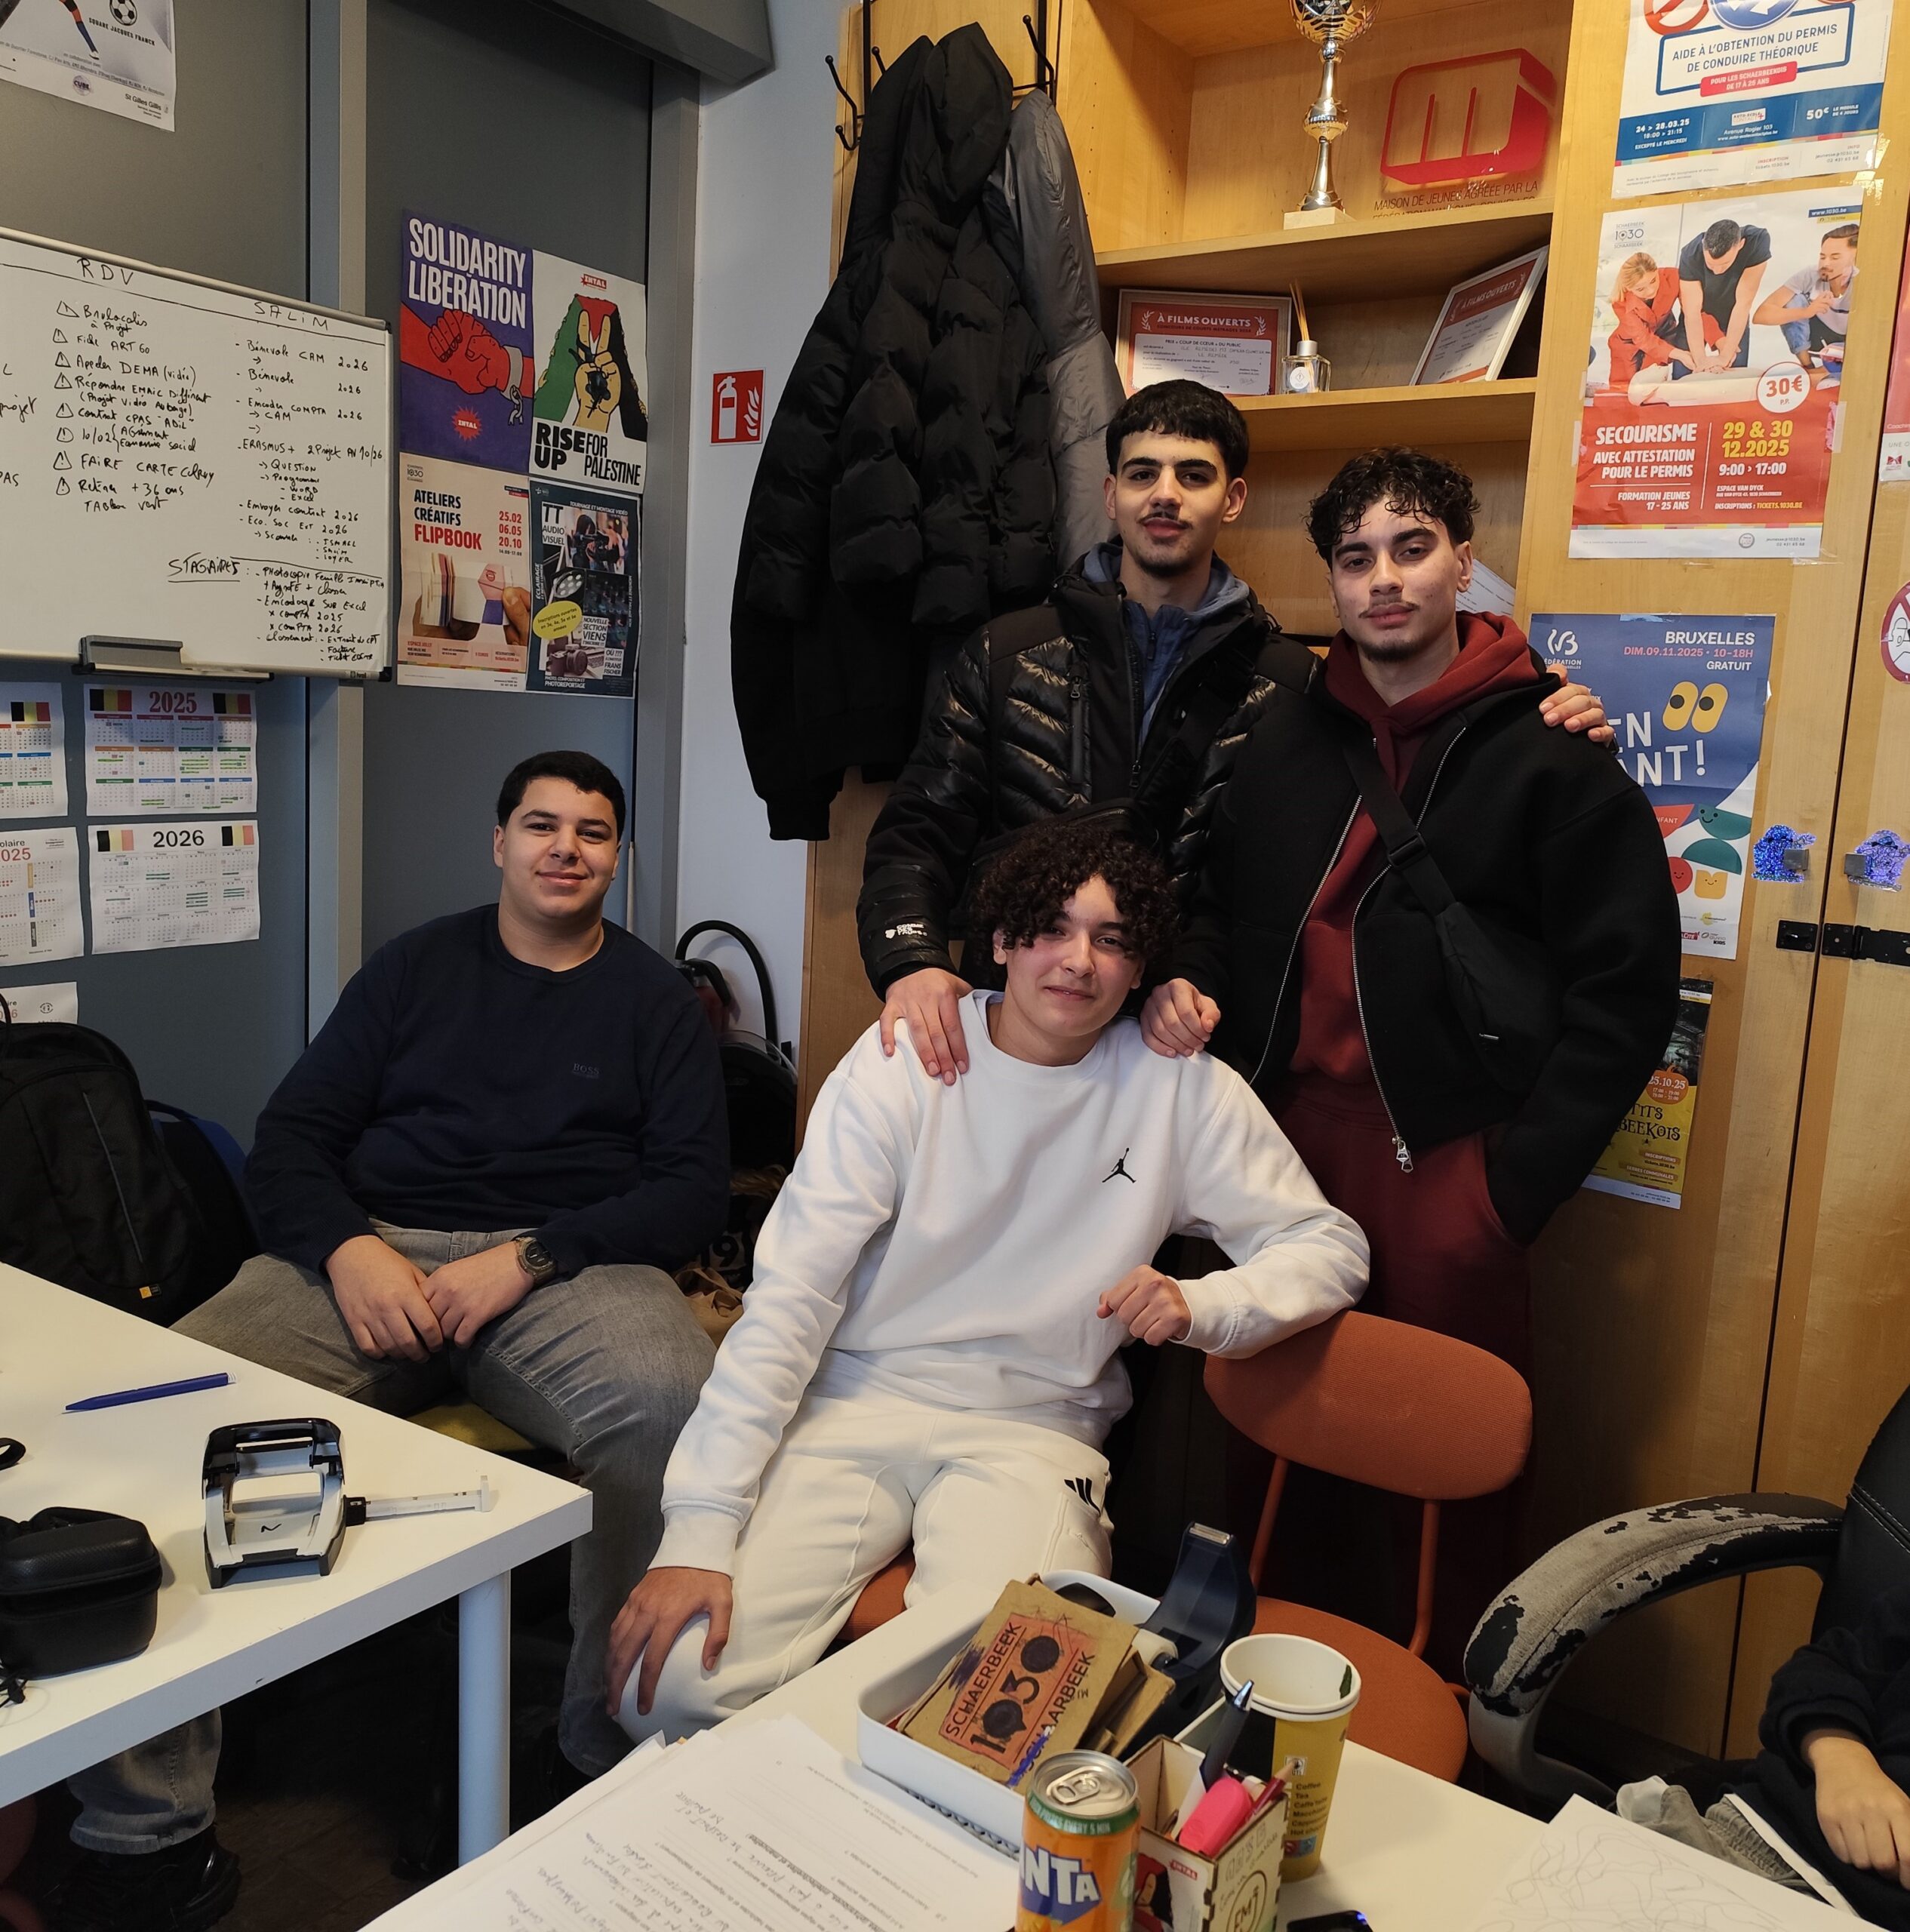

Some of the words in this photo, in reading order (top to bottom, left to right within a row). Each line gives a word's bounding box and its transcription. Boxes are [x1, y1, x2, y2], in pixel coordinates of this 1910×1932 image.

[88, 17, 109, 30] SQUARE
[110, 26, 134, 38] JACQUES
[134, 33, 155, 46] FRANCK
[1672, 45, 1696, 61] AIDE
[1698, 43, 1706, 56] À
[1777, 32, 1792, 48] DU
[1795, 23, 1838, 45] PERMIS
[1687, 62, 1700, 73] DE
[1702, 52, 1756, 71] CONDUIRE
[1759, 42, 1819, 63] THÉORIQUE
[1710, 75, 1727, 85] POUR
[1727, 73, 1738, 83] LES
[1739, 66, 1788, 82] SCHAERBEEKOIS
[1726, 82, 1735, 91] DE
[1736, 81, 1741, 89] 17
[1741, 78, 1748, 88] À
[1757, 76, 1770, 85] ANS
[132, 97, 148, 106] Gilles
[148, 102, 161, 110] Gillis
[1806, 106, 1829, 122] 50€
[1635, 125, 1646, 134] 24
[1655, 118, 1690, 130] 28.03.25
[1724, 127, 1744, 136] Avenue
[1745, 125, 1762, 135] Rogier
[1663, 137, 1687, 147] MERCREDI
[1373, 198, 1410, 211] MAISON
[1411, 195, 1425, 207] DE
[1426, 192, 1462, 205] JEUNES
[1503, 183, 1523, 195] PAR
[1524, 180, 1538, 192] LA
[1615, 229, 1644, 242] 1030
[409, 218, 526, 288] SOLIDARITY
[77, 258, 134, 285] RDV
[1158, 312, 1164, 323] À
[1167, 315, 1200, 325] FILMS
[1201, 317, 1251, 327] OUVERTS
[111, 340, 137, 352] ART
[139, 343, 149, 354] 60
[299, 351, 324, 364] CAM
[338, 356, 368, 371] 2026
[118, 361, 159, 377] DEMA
[338, 383, 361, 395] 2026
[1766, 375, 1803, 398] 30€
[337, 409, 362, 420] 2026
[1595, 423, 1698, 445] SECOURISME
[1722, 421, 1746, 439] 29
[1749, 421, 1765, 438] &
[1769, 420, 1793, 438] 30
[536, 421, 586, 454] RISE
[586, 432, 608, 459] FOR
[1721, 439, 1790, 459] 12.2025
[534, 445, 567, 471] UP
[1593, 451, 1621, 465] AVEC
[1622, 449, 1696, 463] ATTESTATION
[137, 462, 178, 476] CARTE
[407, 468, 423, 478] 1030
[584, 454, 641, 487] PALESTINE
[1601, 466, 1632, 479] POUR
[1635, 466, 1647, 478] LE
[1650, 464, 1694, 478] PERMIS
[1718, 463, 1745, 476] 9:00
[1755, 462, 1787, 475] 17:00
[414, 489, 461, 509] ATELIERS
[1617, 491, 1662, 501] FORMATION
[1662, 491, 1691, 500] JEUNES
[570, 501, 591, 509] TOURNAGE
[1646, 502, 1654, 511] 17
[1660, 501, 1672, 510] 25
[1672, 501, 1690, 509] ANS
[334, 509, 358, 521] 2026
[414, 506, 461, 526] CRÉATIFS
[499, 511, 521, 524] 25.02
[322, 525, 347, 535] 2026
[414, 523, 482, 550] FLIPBOOK
[499, 524, 521, 536] 06.05
[543, 525, 564, 535] AUDIO
[499, 537, 522, 549] 20.10
[543, 535, 564, 545] VISUEL
[317, 612, 343, 622] 2025
[538, 614, 560, 623] Inscriptions
[561, 608, 577, 616] ouvertes
[318, 624, 343, 633] 2026
[583, 631, 606, 641] VIENS
[1665, 631, 1756, 646] BRUXELLES
[1624, 647, 1704, 657] DIM.09.11.2025
[1706, 661, 1752, 671] GRATUIT
[148, 691, 198, 713] 2025
[152, 829, 205, 848] 2026
[574, 1063, 599, 1075] BOSS
[945, 1621, 1023, 1737] SCHAERBEEK
